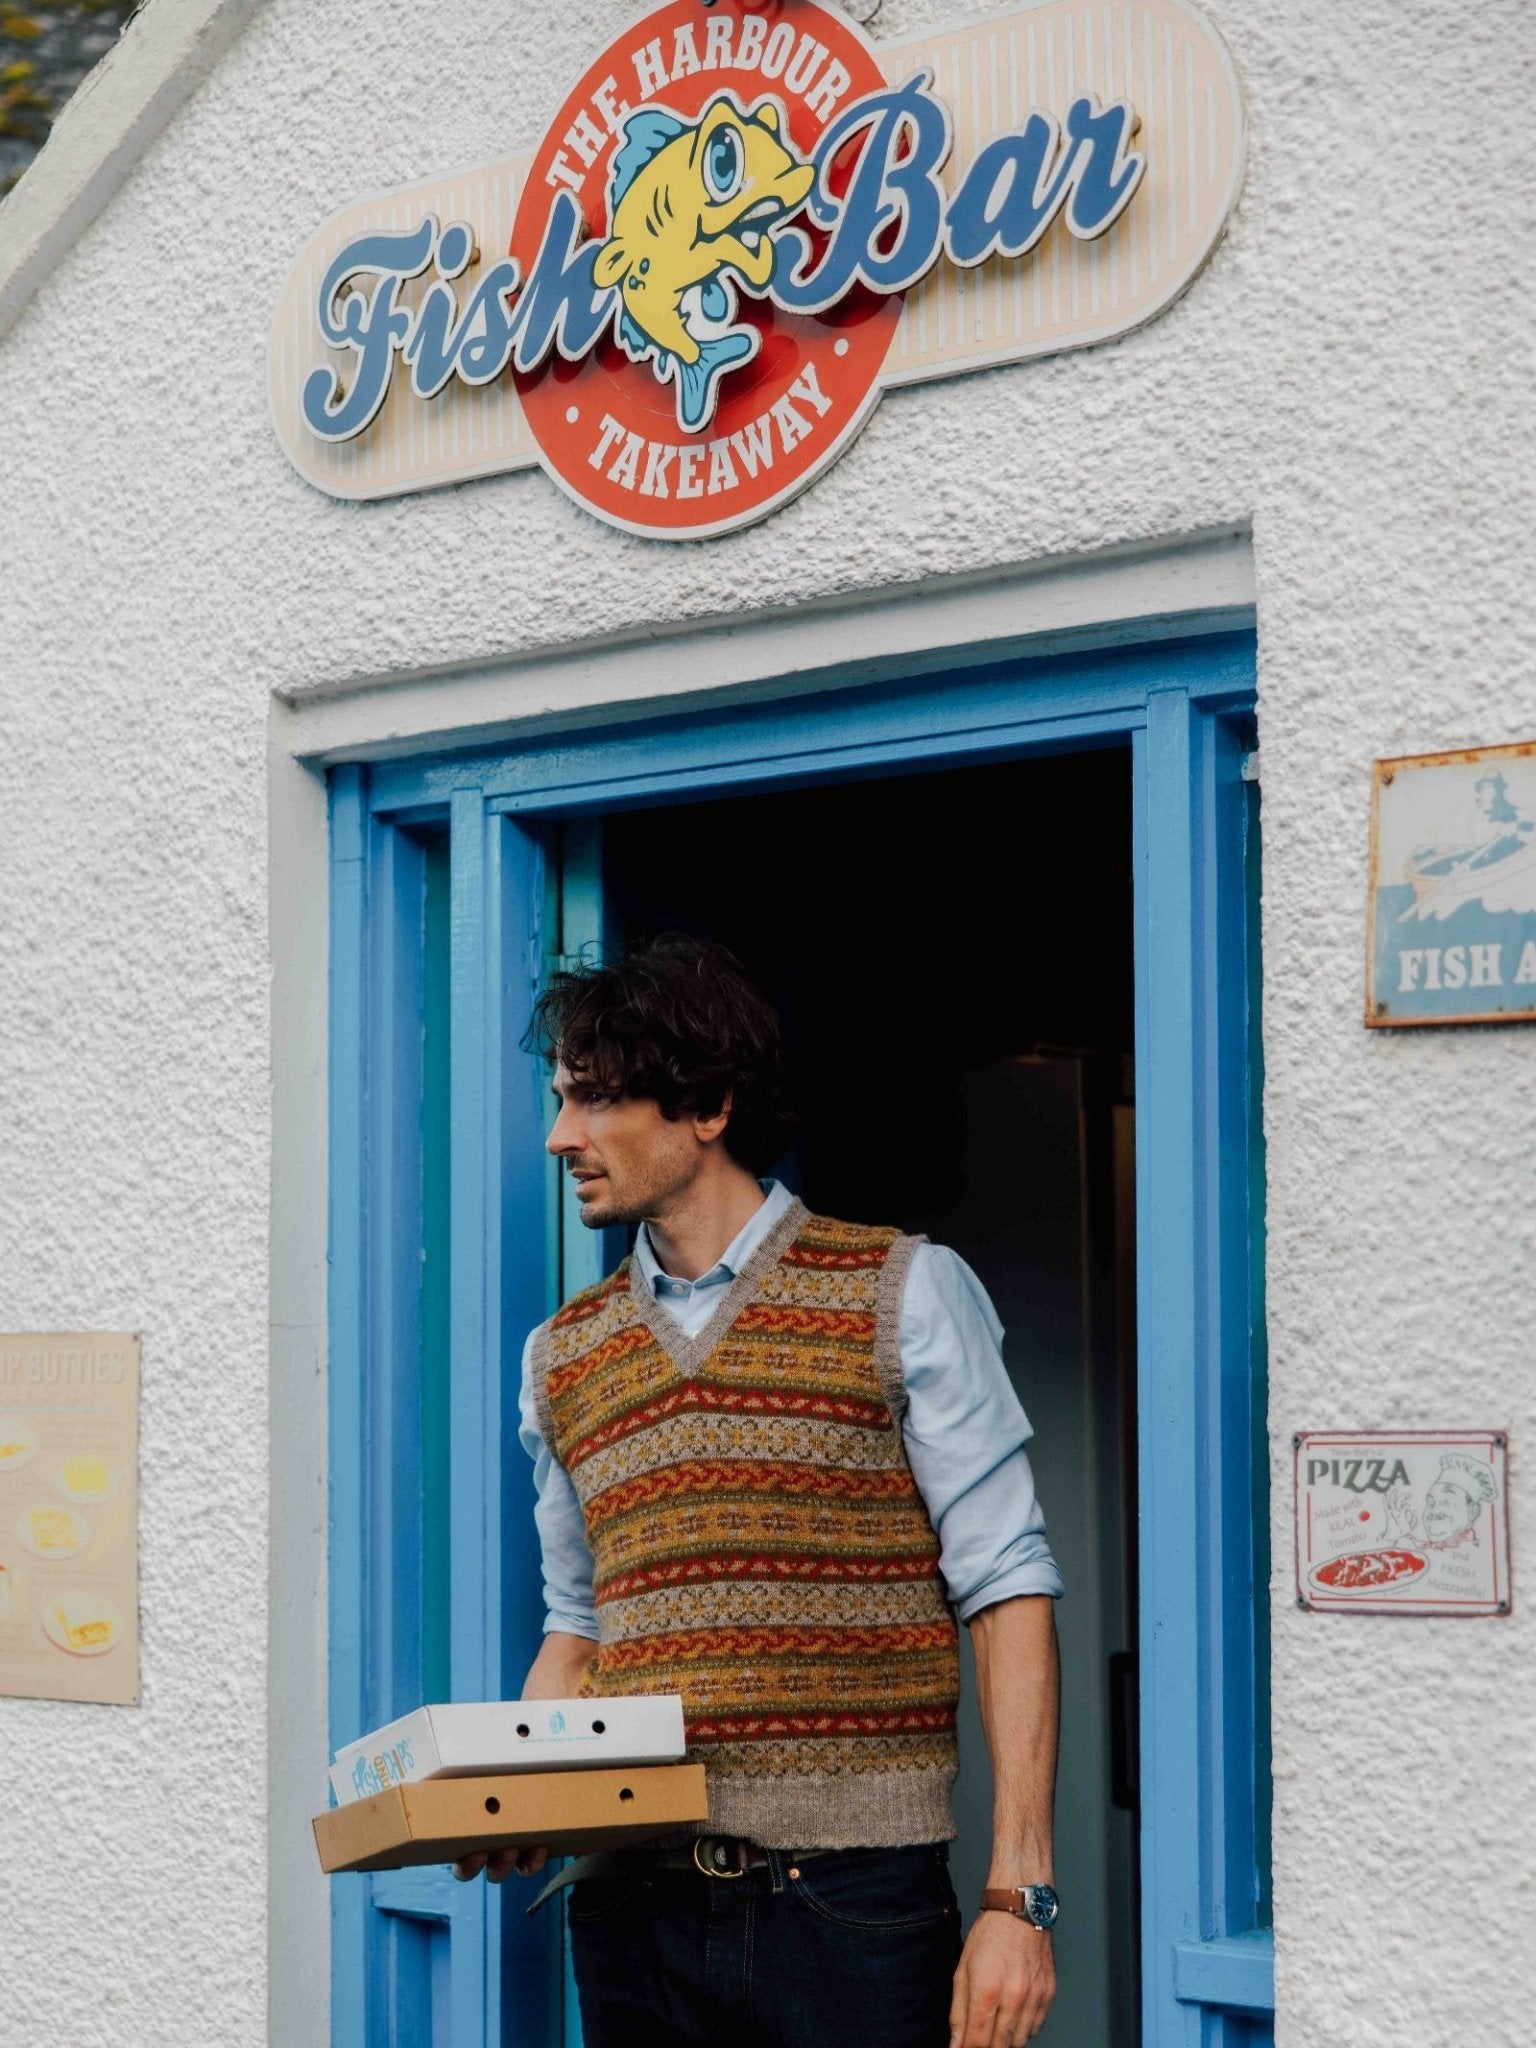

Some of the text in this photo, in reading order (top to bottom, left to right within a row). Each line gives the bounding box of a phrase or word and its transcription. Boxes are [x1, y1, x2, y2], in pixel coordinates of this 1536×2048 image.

[544, 15, 852, 194] THE HARBOUR
[300, 69, 1147, 441] Fish Bar
[588, 363, 834, 500] TAKEAWAY
[1398, 943, 1503, 992] FISH
[1306, 1459, 1412, 1494] PIZZA
